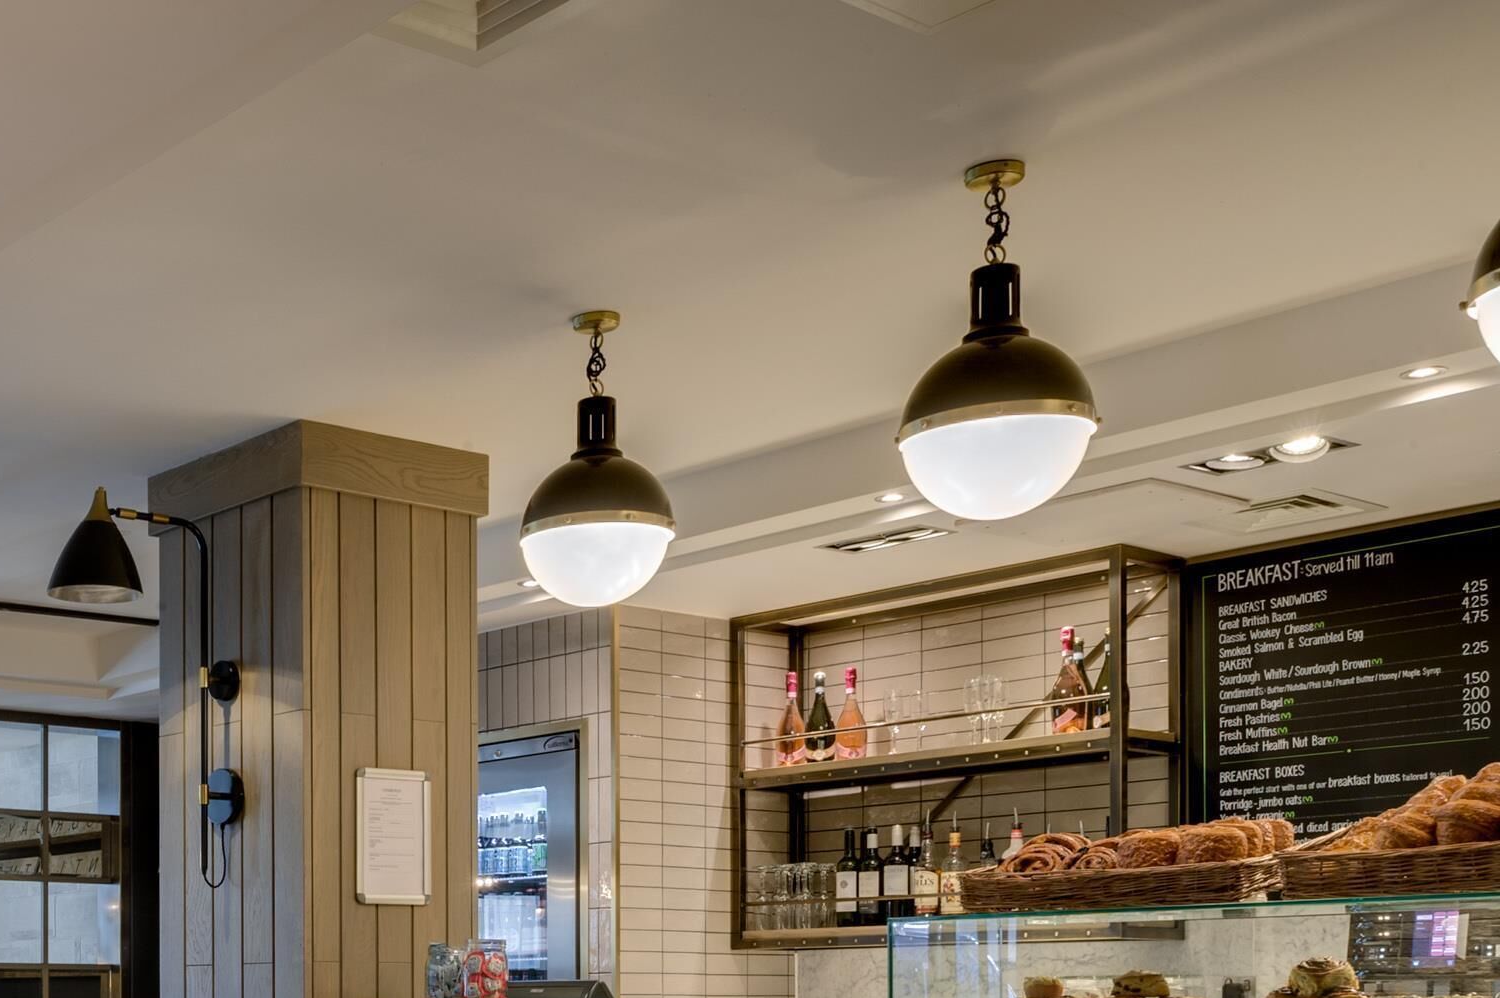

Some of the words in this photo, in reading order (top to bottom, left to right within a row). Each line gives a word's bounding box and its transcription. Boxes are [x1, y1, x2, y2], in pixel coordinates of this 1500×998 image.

[1305, 556, 1344, 577] Served
[1347, 554, 1361, 571] till
[1364, 551, 1394, 568] 11am
[1218, 599, 1266, 617] BREAKFAST
[1270, 589, 1328, 609] SANDWICHES
[1218, 617, 1240, 631] Great
[1242, 614, 1269, 628] British
[1272, 611, 1297, 623] Bacon
[1219, 632, 1247, 645] Classic
[1250, 627, 1281, 641] Wookey
[1219, 644, 1252, 659] Smoked
[1254, 640, 1285, 654] Salmon
[1288, 637, 1294, 649] &
[1298, 631, 1344, 648] Scrambled
[1347, 628, 1364, 642] Egg
[1219, 670, 1261, 686] Sourdough
[1462, 640, 1490, 656] 2.25
[1219, 656, 1254, 672] BAKERY
[1219, 699, 1258, 714] Cinnamon
[1219, 715, 1242, 729] Fresh
[1219, 729, 1242, 743] Fresh
[1219, 742, 1260, 757] Breakfast
[1262, 738, 1289, 752] Health
[1292, 737, 1309, 749] Nut
[1219, 766, 1270, 784] BREAKFAST
[1275, 764, 1305, 779] BOXES
[1328, 775, 1371, 789] breakfast
[1374, 773, 1401, 785] boxes
[1402, 772, 1428, 782] tailored
